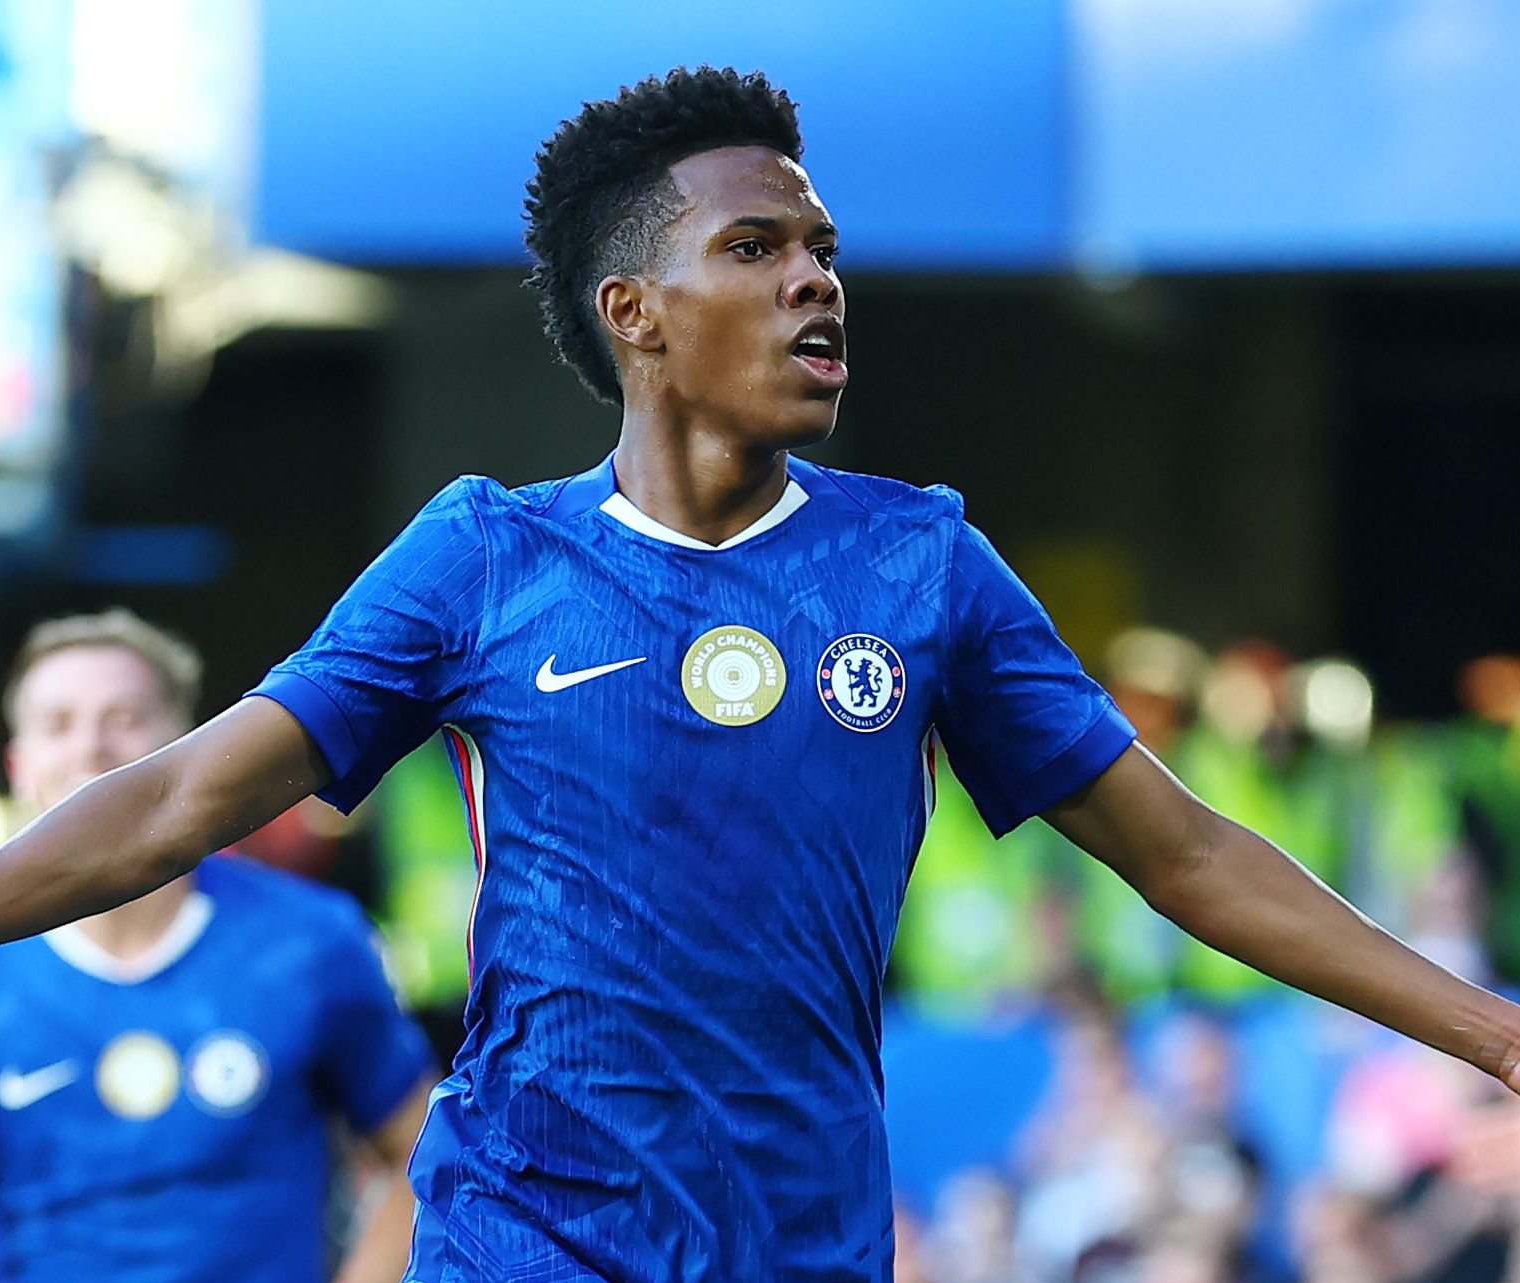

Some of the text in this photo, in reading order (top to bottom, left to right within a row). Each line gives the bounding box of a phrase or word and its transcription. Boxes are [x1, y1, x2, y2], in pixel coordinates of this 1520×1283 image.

[830, 638, 887, 659] CHELSEA
[691, 634, 777, 689] WORLD CHAMPIONS
[715, 702, 755, 717] FIFA
[836, 708, 892, 727] FOOTBALL CLUB
